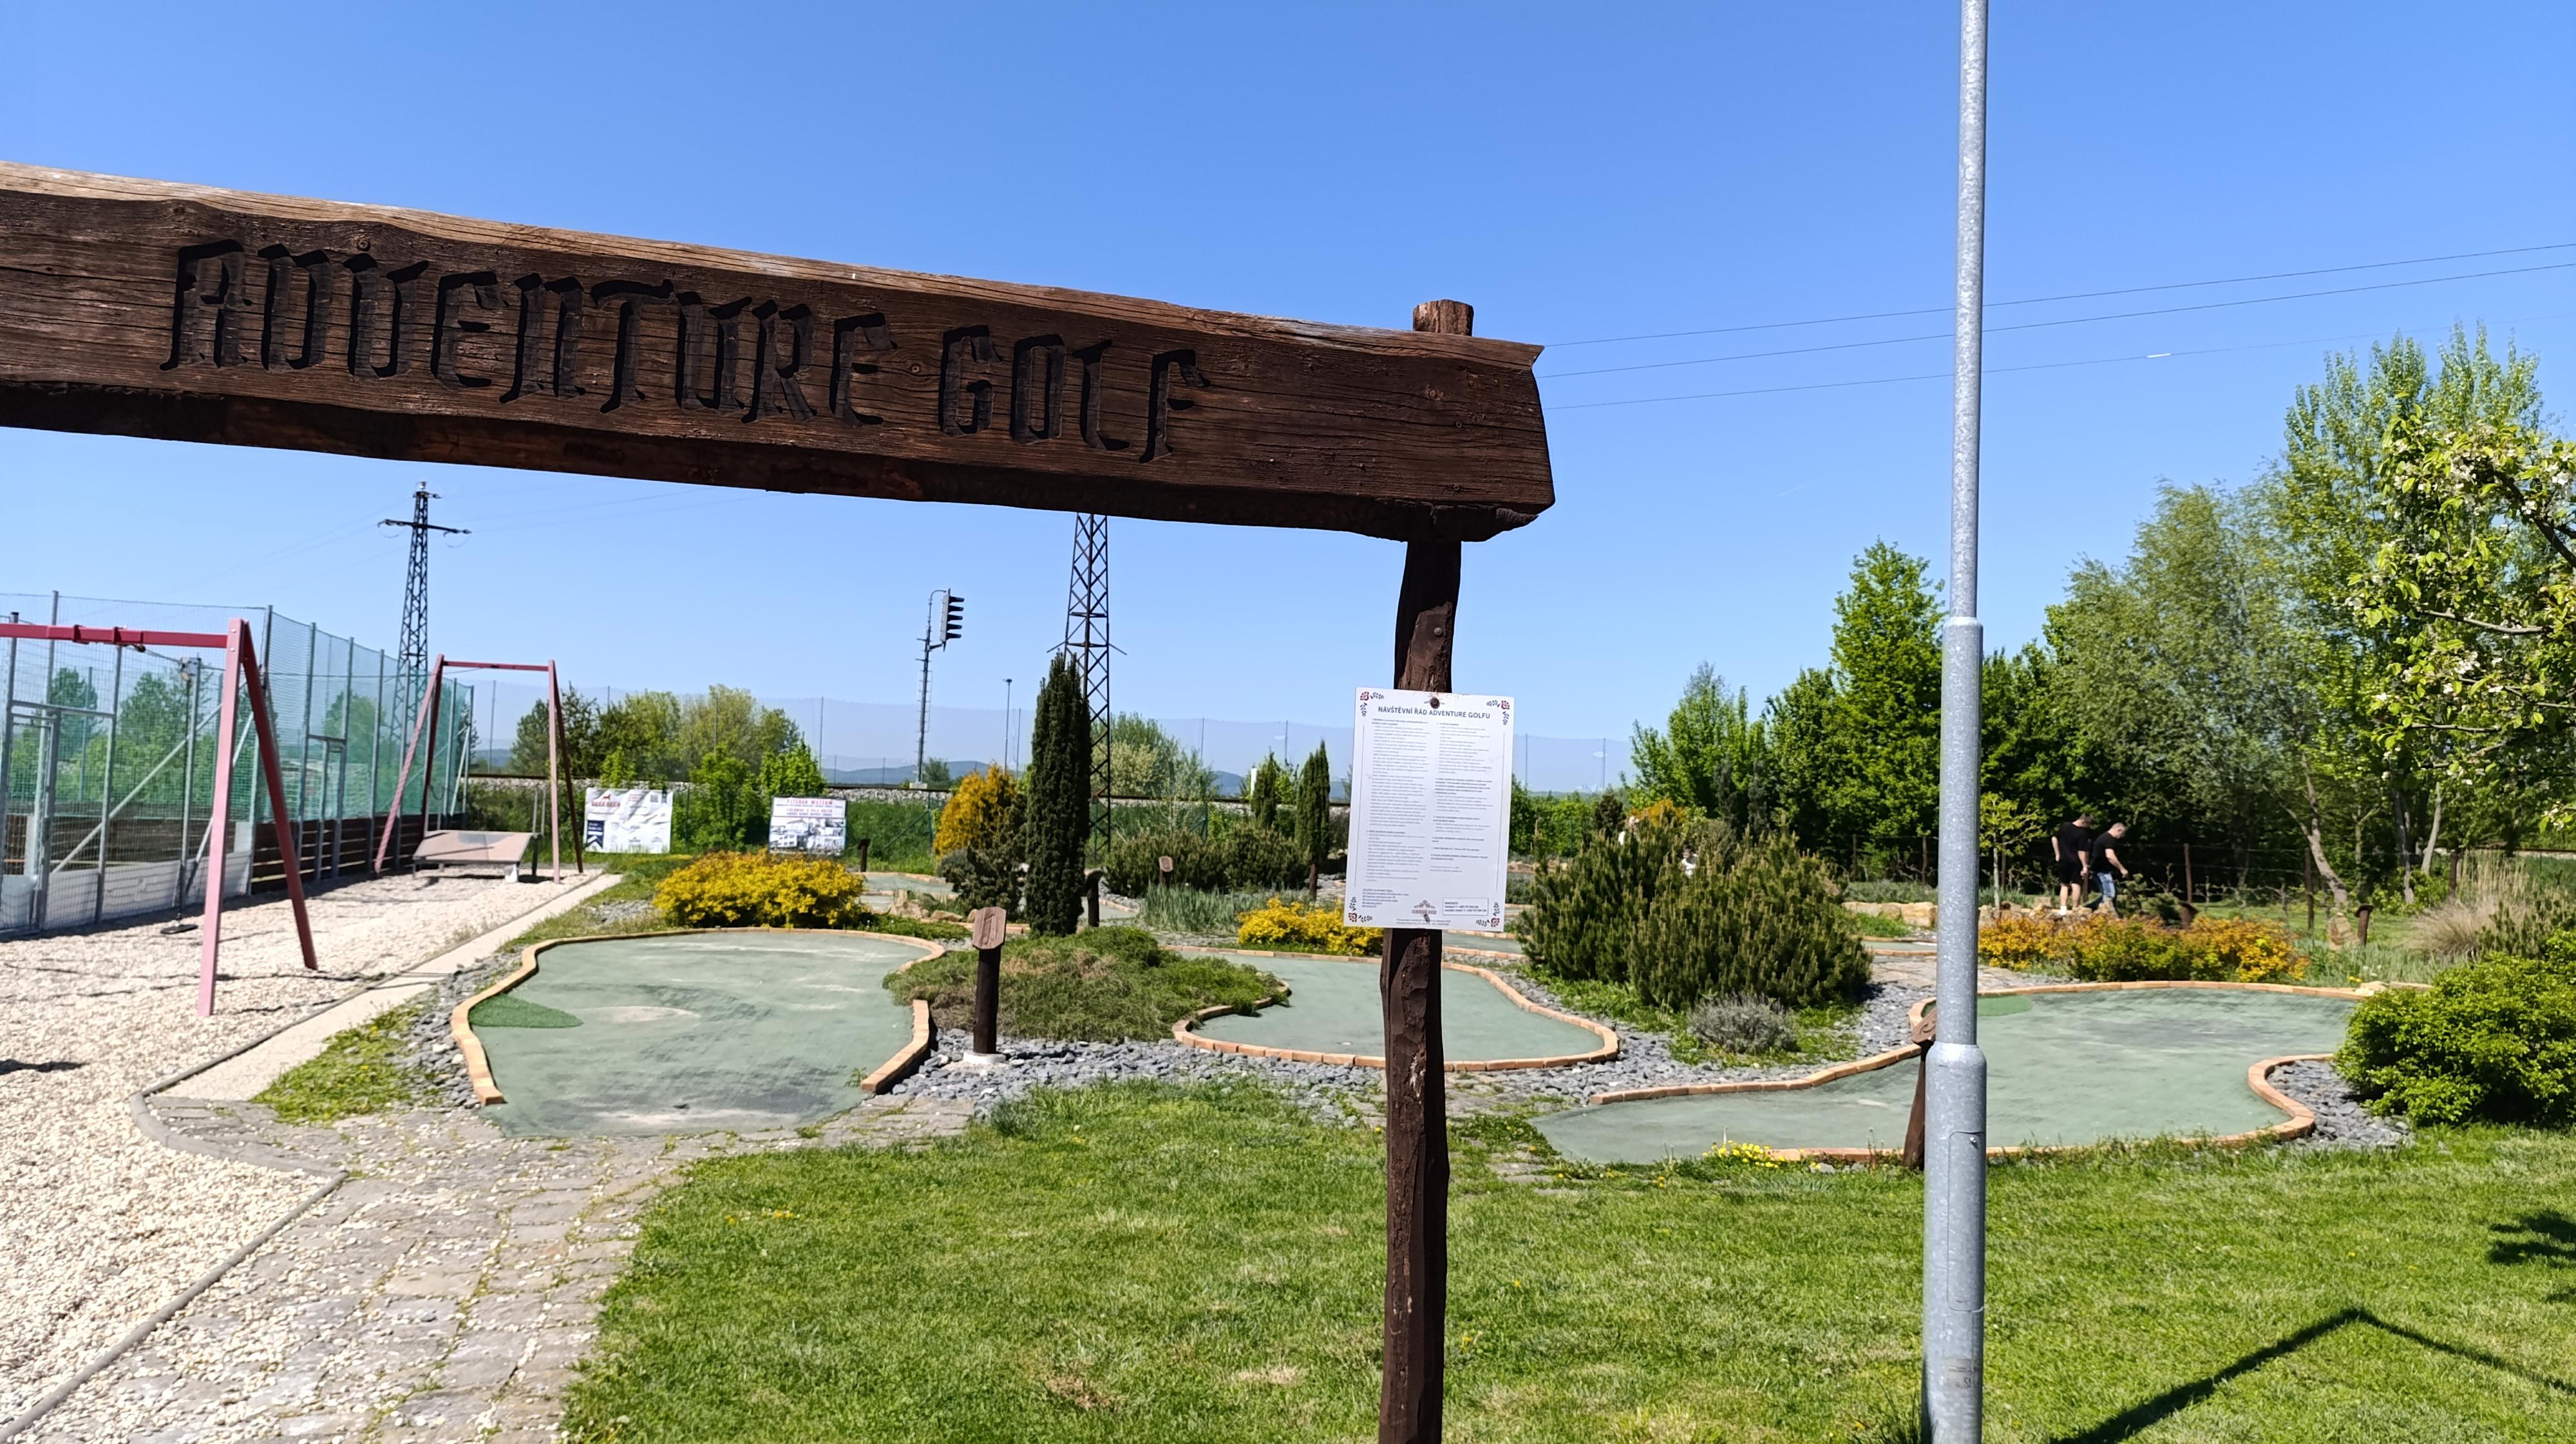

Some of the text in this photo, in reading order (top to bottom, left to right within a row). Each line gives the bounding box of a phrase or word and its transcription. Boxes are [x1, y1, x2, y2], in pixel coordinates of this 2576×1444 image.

[159, 238, 1211, 464] ADVENTURE GOLF
[1414, 707, 1428, 715] ŘÁD
